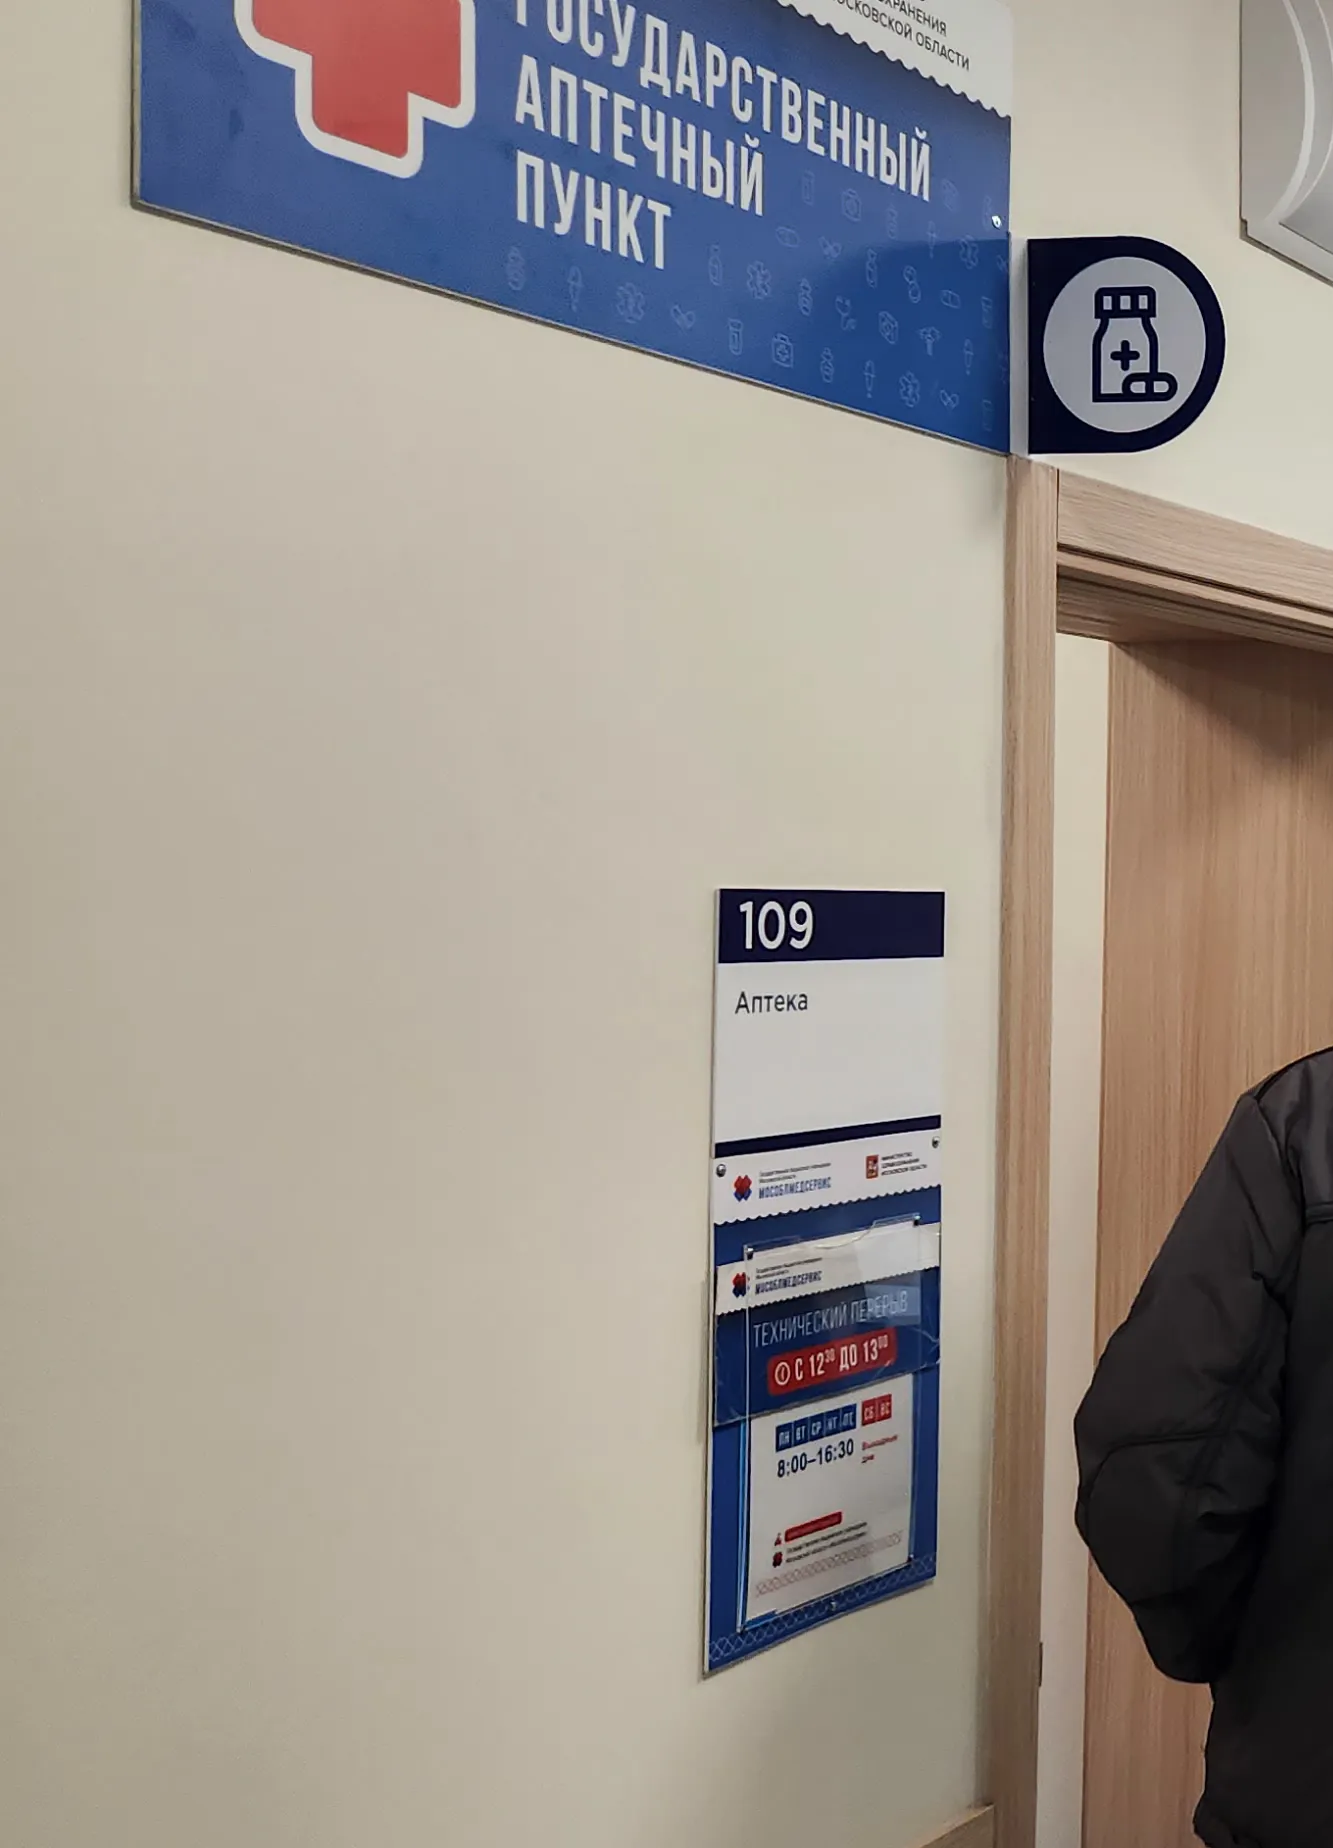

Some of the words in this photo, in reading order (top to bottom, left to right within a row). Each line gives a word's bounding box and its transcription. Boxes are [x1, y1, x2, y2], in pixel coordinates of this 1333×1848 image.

[833, 0, 913, 41] СКОВСКОЙ
[915, 31, 970, 71] ОБЛАСТИ
[515, 54, 764, 217] АПТЕЧНЫЙ
[516, 150, 672, 270] ПУНКТ
[740, 901, 813, 949] 109
[735, 991, 808, 1014] Аптека
[753, 1302, 847, 1348] ТЕХНИЧЕСКИЙ
[851, 1290, 909, 1325] ПЕРЕРЫВ
[794, 1358, 804, 1381] С
[839, 1344, 858, 1373] ДО
[811, 1420, 822, 1436] СР
